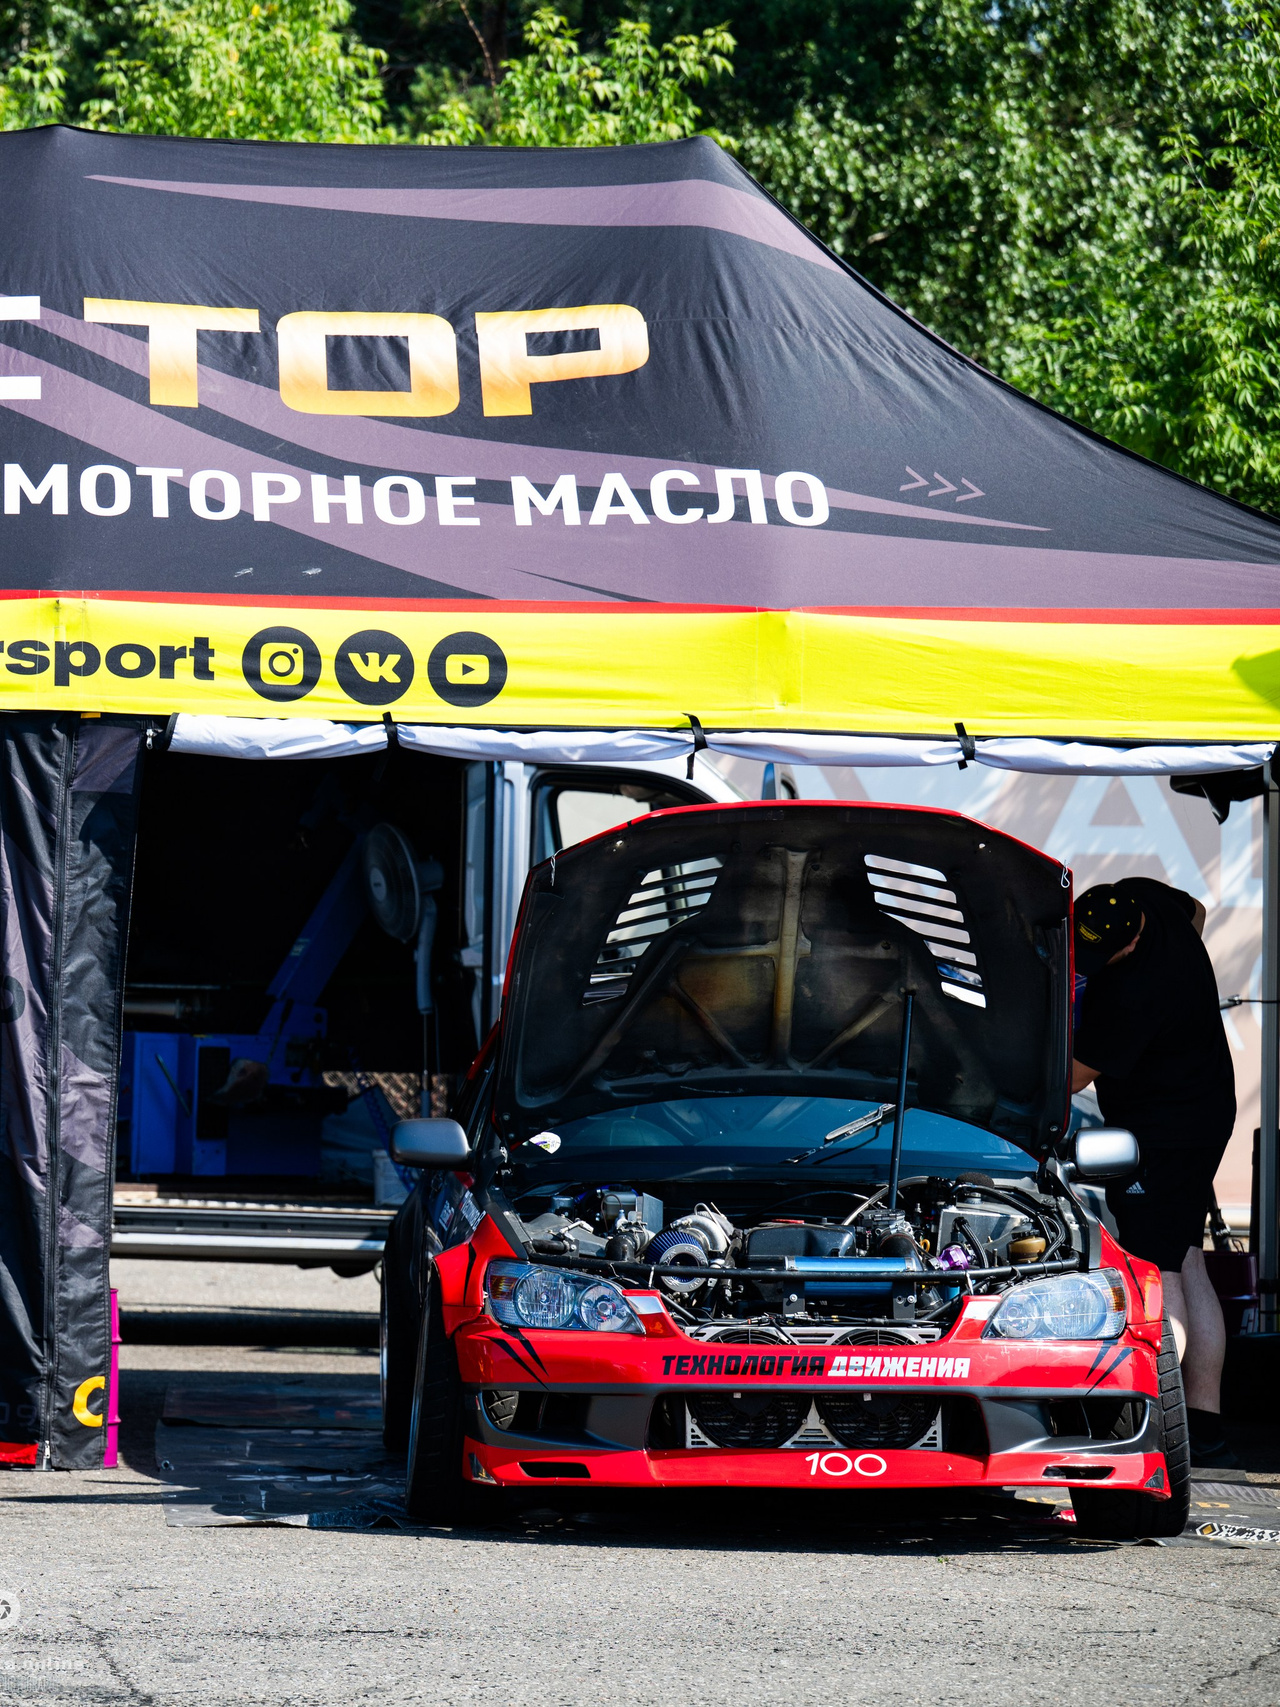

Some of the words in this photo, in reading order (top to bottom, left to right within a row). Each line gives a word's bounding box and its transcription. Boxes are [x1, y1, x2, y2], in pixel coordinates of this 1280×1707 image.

[83, 297, 650, 418] TOP
[4, 463, 481, 526] МОТОРНОЕ
[510, 468, 830, 527] МАСЛО
[662, 1355, 826, 1376] ТЕХНОЛОГИЯ
[827, 1356, 971, 1379] ДВИЖЕНИЯ
[805, 1452, 888, 1477] 100
